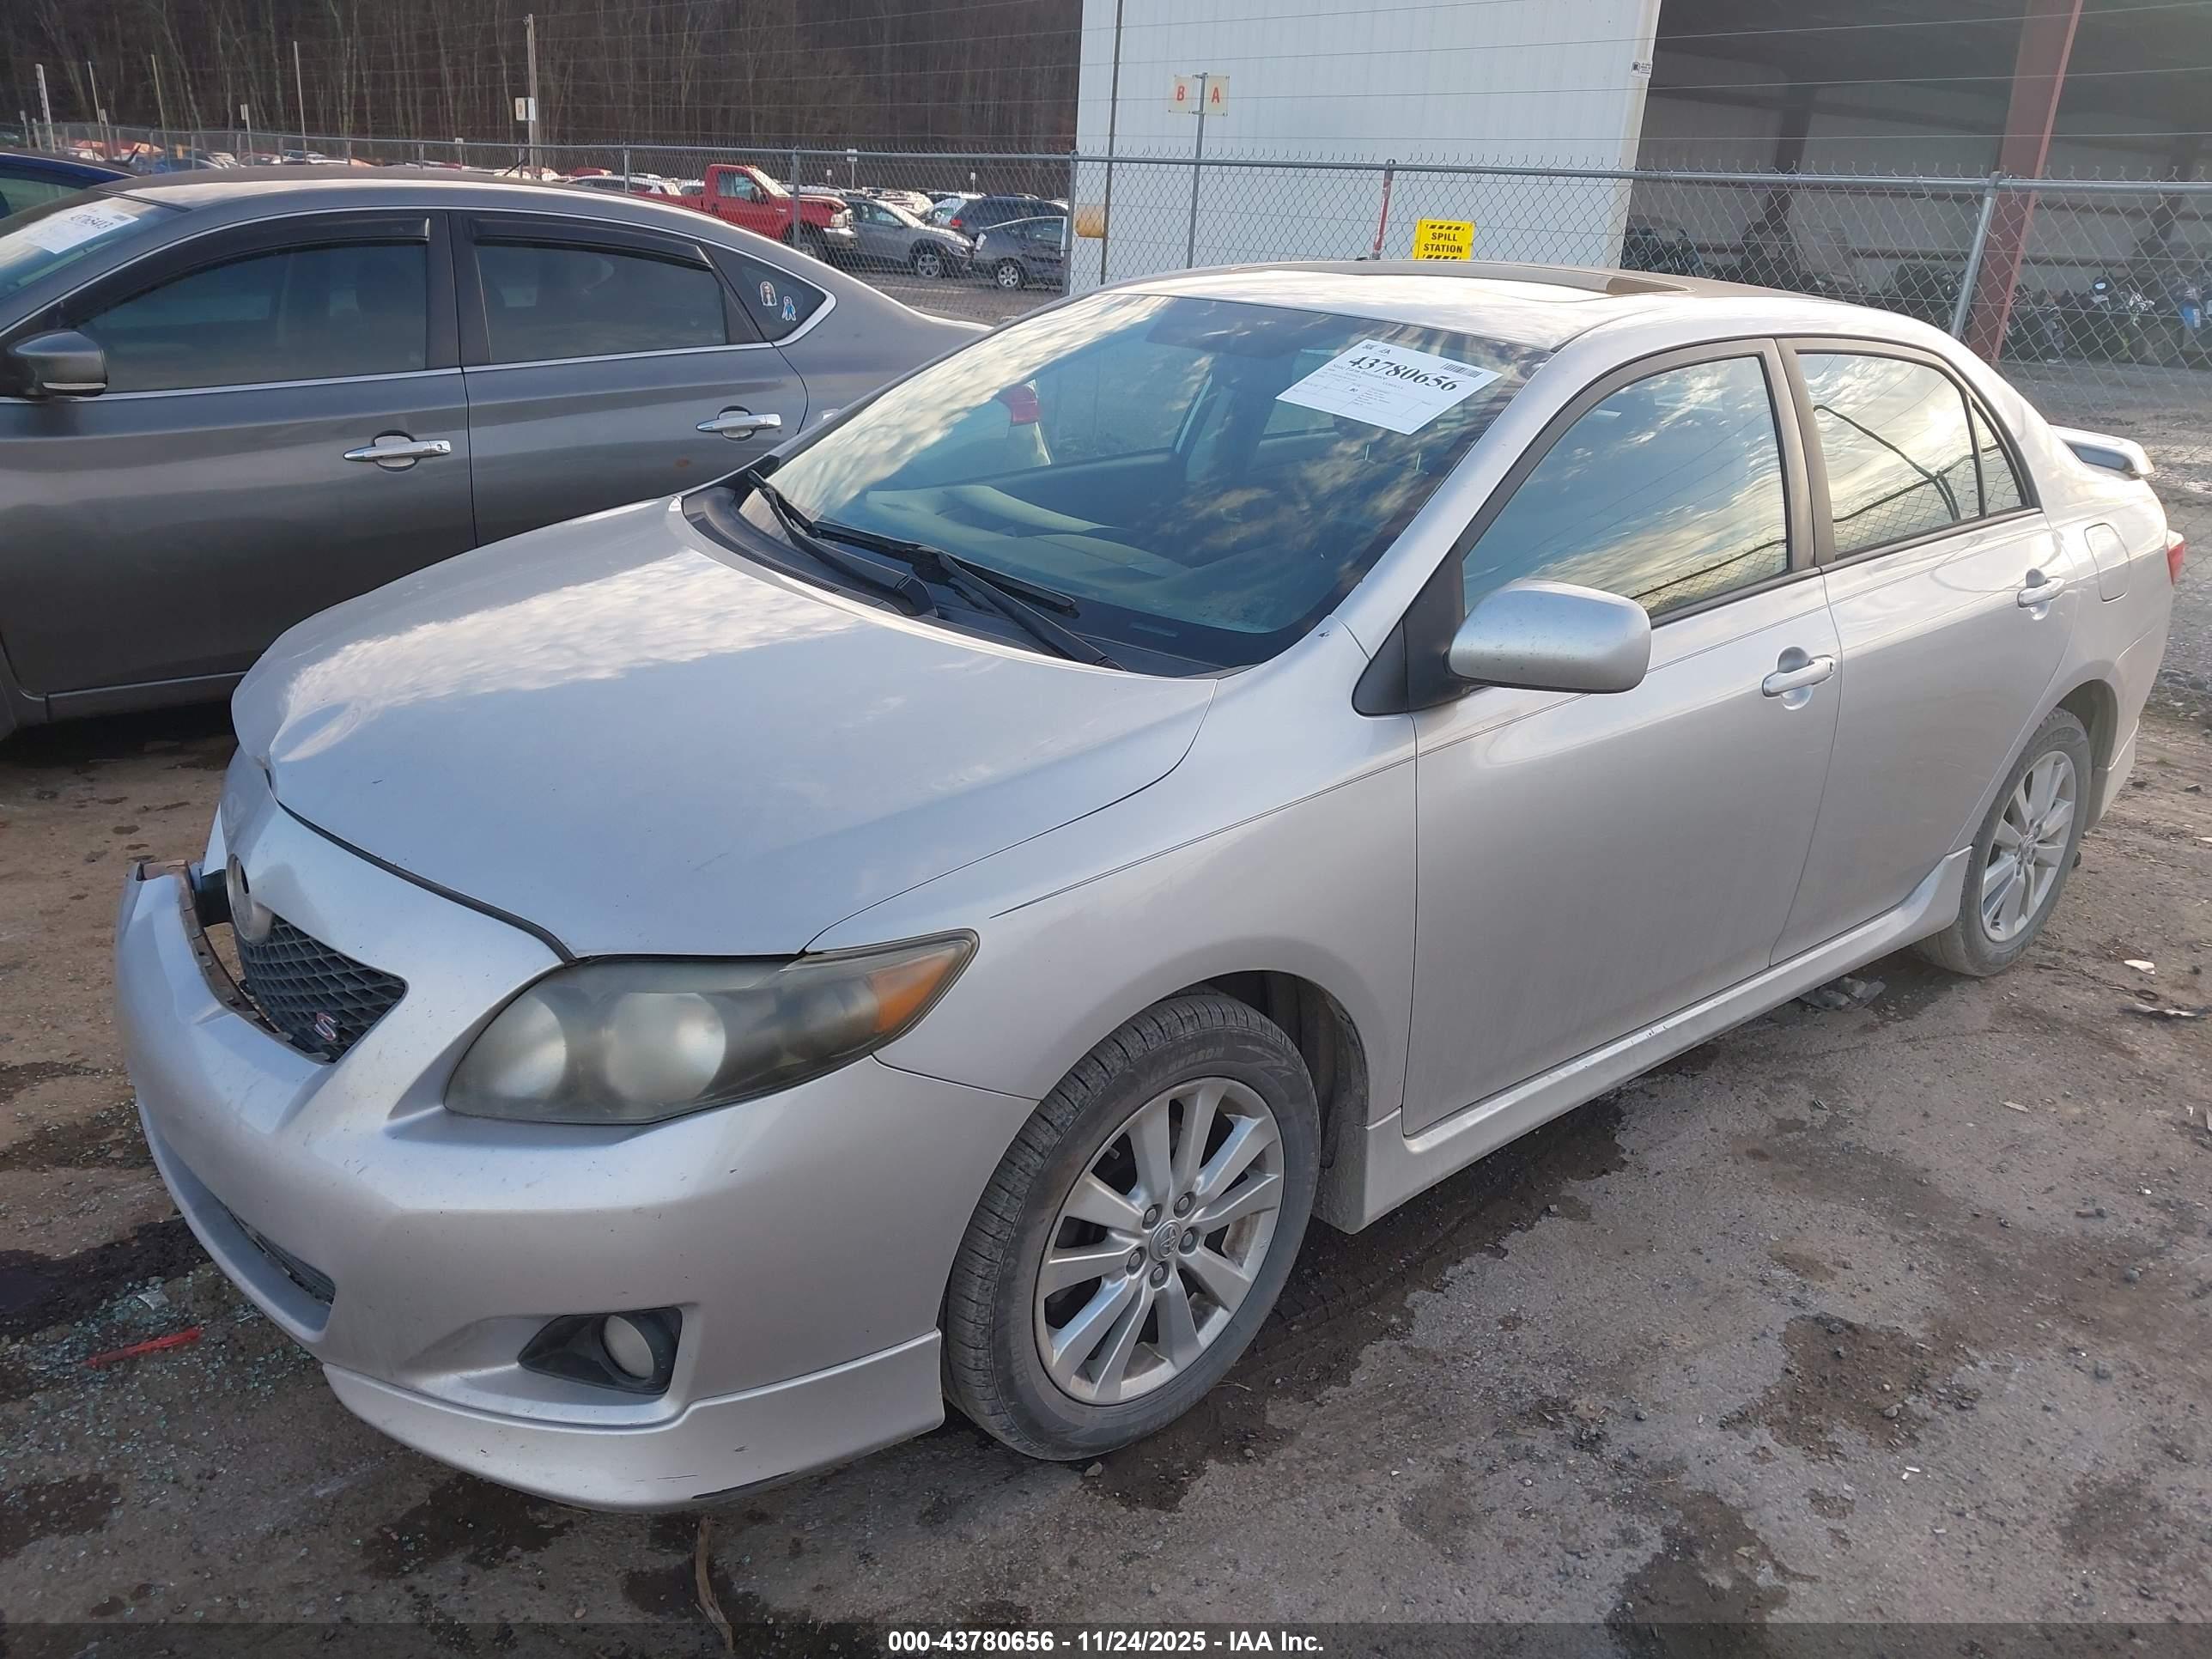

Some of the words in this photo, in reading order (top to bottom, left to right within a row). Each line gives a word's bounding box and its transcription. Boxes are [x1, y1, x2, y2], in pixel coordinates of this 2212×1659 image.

[1176, 85, 1185, 101] B
[1212, 87, 1220, 103] A
[1431, 232, 1457, 241] SPILL
[1424, 243, 1463, 253] STATION
[1348, 356, 1465, 392] 43780656
